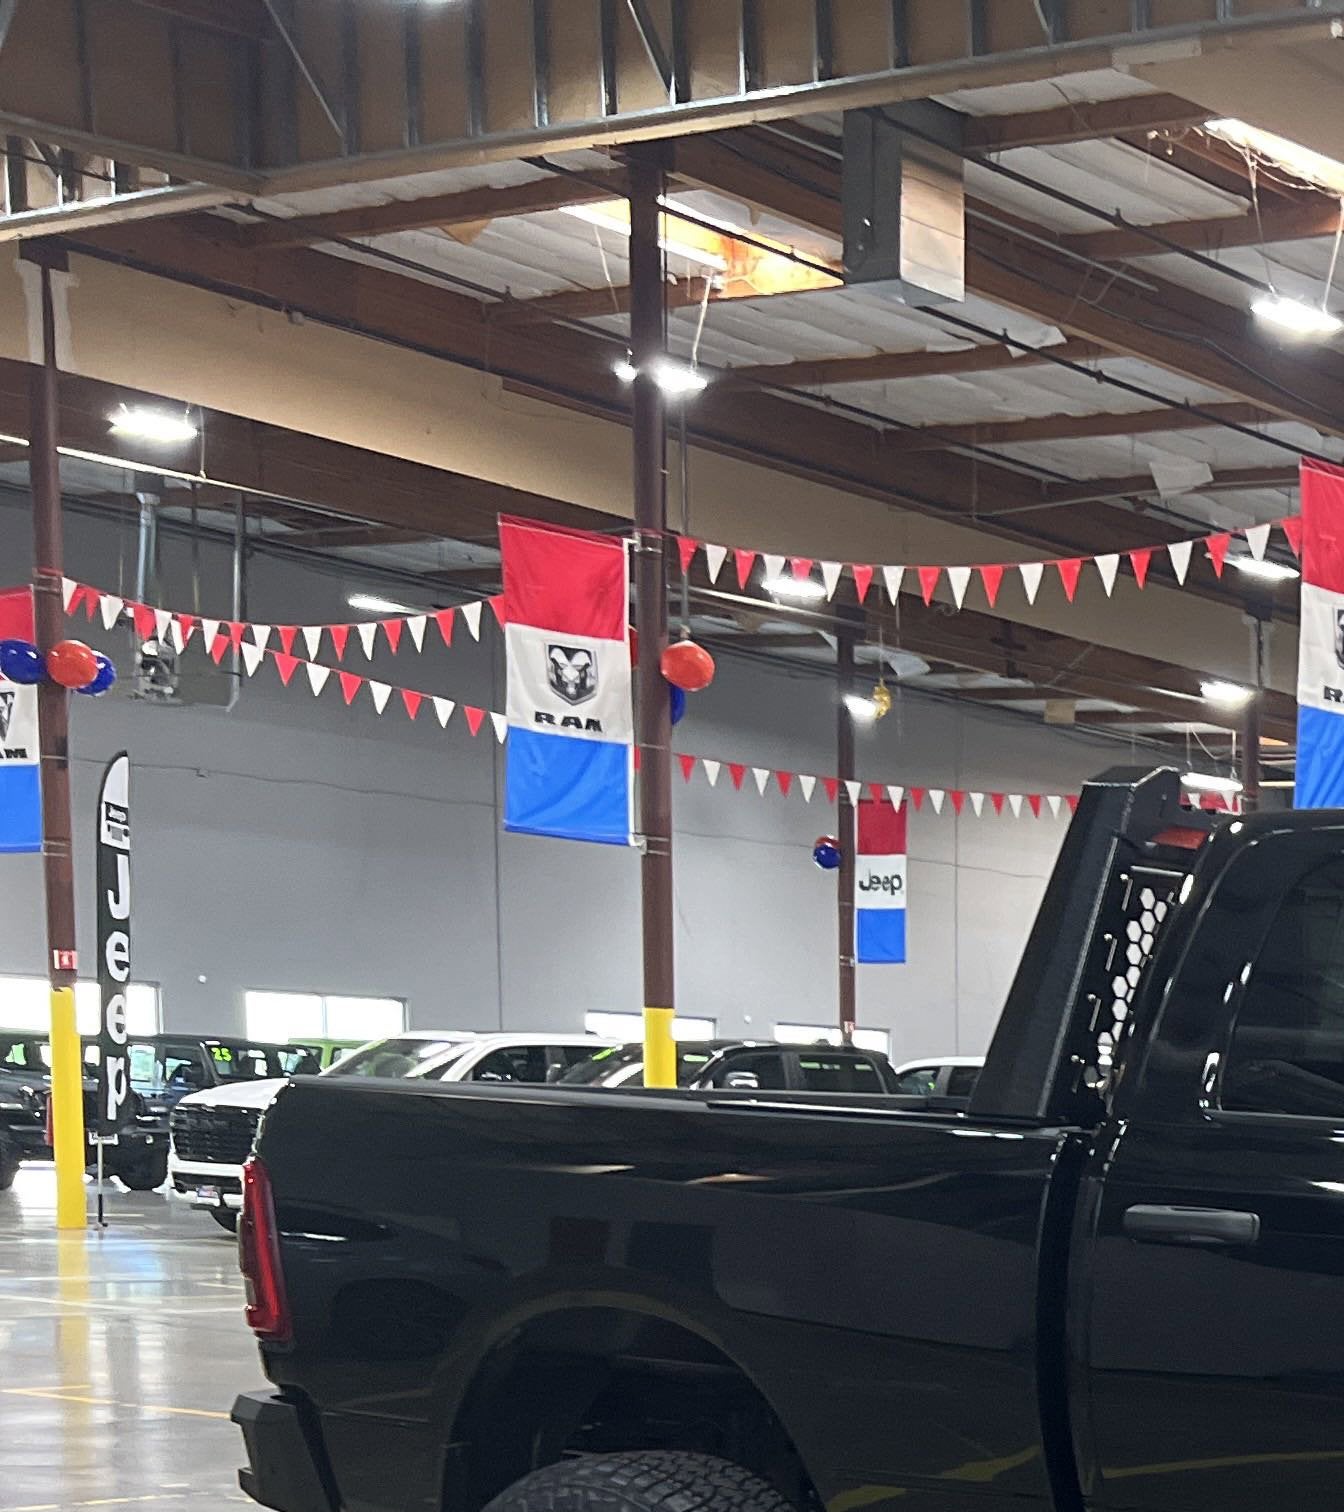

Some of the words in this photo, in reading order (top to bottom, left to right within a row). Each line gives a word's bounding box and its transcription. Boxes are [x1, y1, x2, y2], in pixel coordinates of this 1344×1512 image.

[534, 711, 603, 733] RAM
[858, 867, 903, 896] Jeep
[105, 853, 132, 1121] Jeep
[211, 1047, 233, 1062] 25
